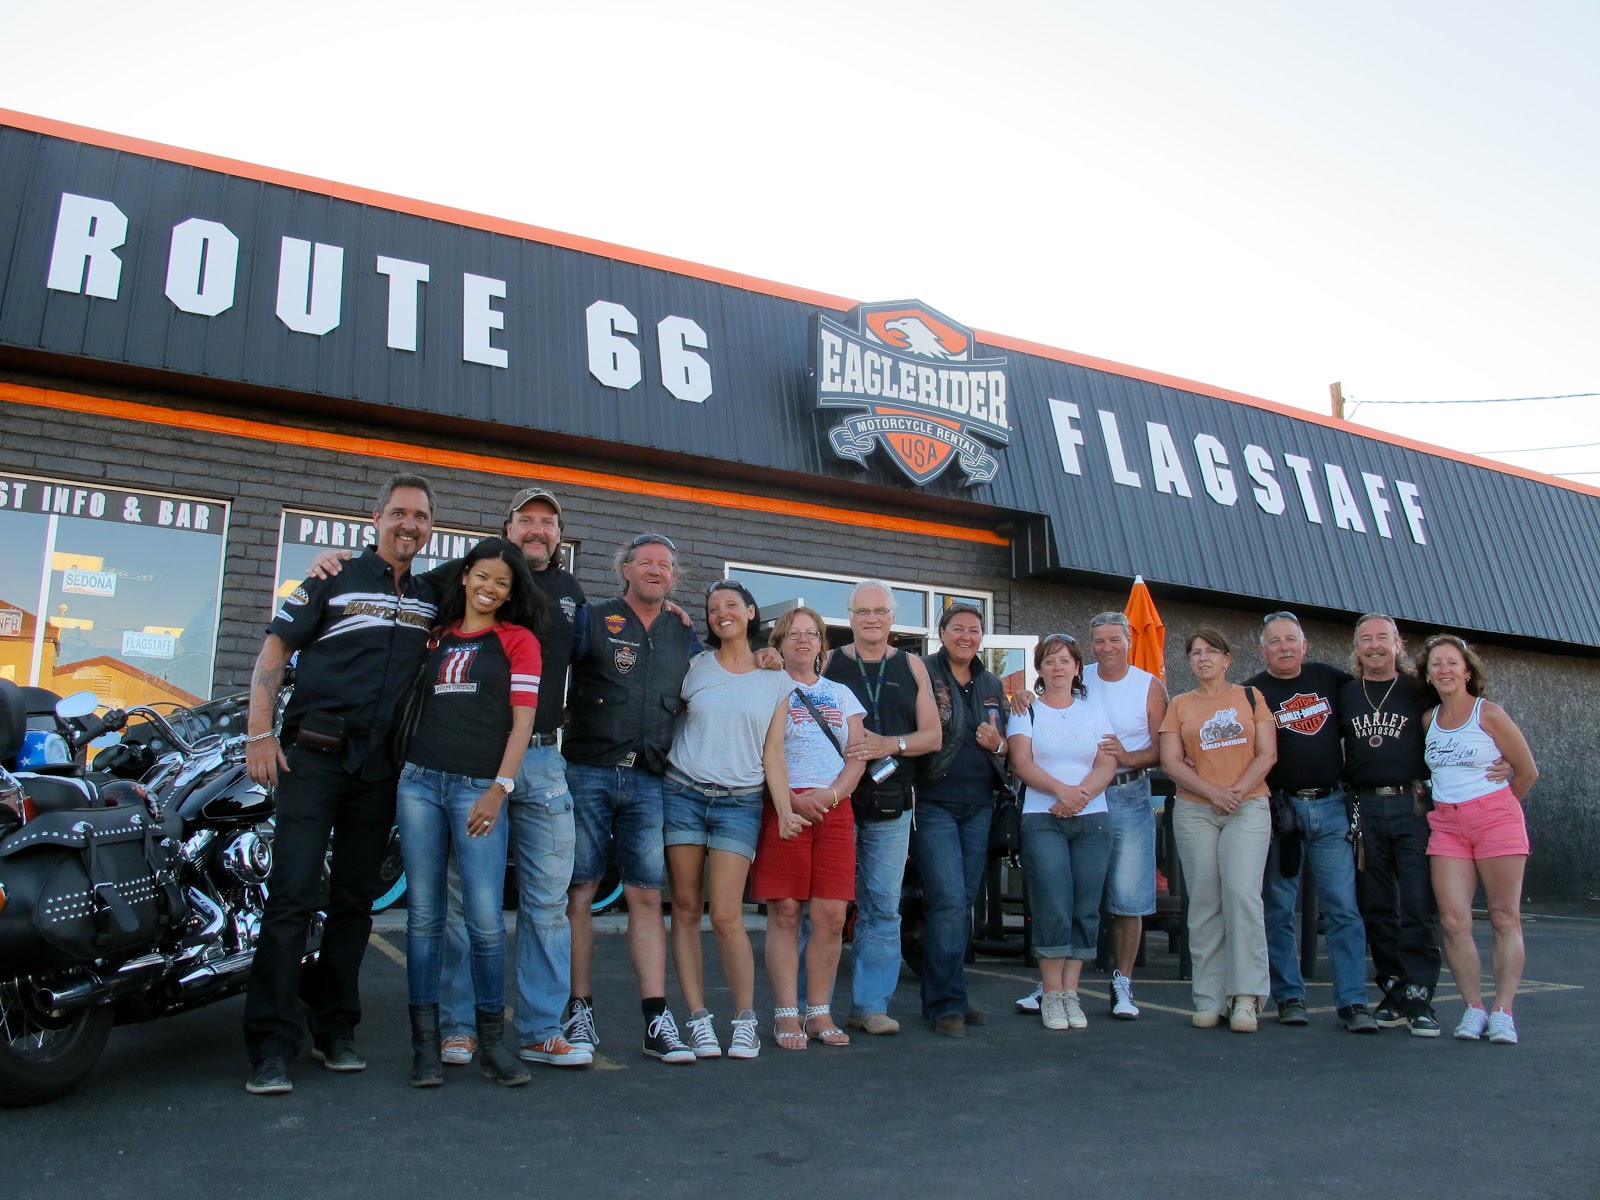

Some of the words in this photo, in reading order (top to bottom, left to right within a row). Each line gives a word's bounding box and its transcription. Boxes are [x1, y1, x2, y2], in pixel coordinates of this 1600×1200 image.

[47, 192, 508, 369] ROUTE
[586, 300, 713, 403] 66
[821, 328, 1008, 430] EAGLERIDER
[857, 417, 933, 435] MOTORCYCLE
[937, 428, 976, 456] RENTAL
[901, 438, 938, 468] USA
[1048, 398, 1426, 545] FLAGSTAFF
[41, 486, 106, 517] INFO
[123, 496, 142, 522] &
[158, 500, 210, 530] BAR
[299, 518, 376, 547] PARTS
[66, 573, 113, 590] SEDONA
[126, 637, 173, 652] FLAGSTAFF
[1351, 712, 1409, 731] HARLEY
[1355, 726, 1400, 739] DAVIDSON
